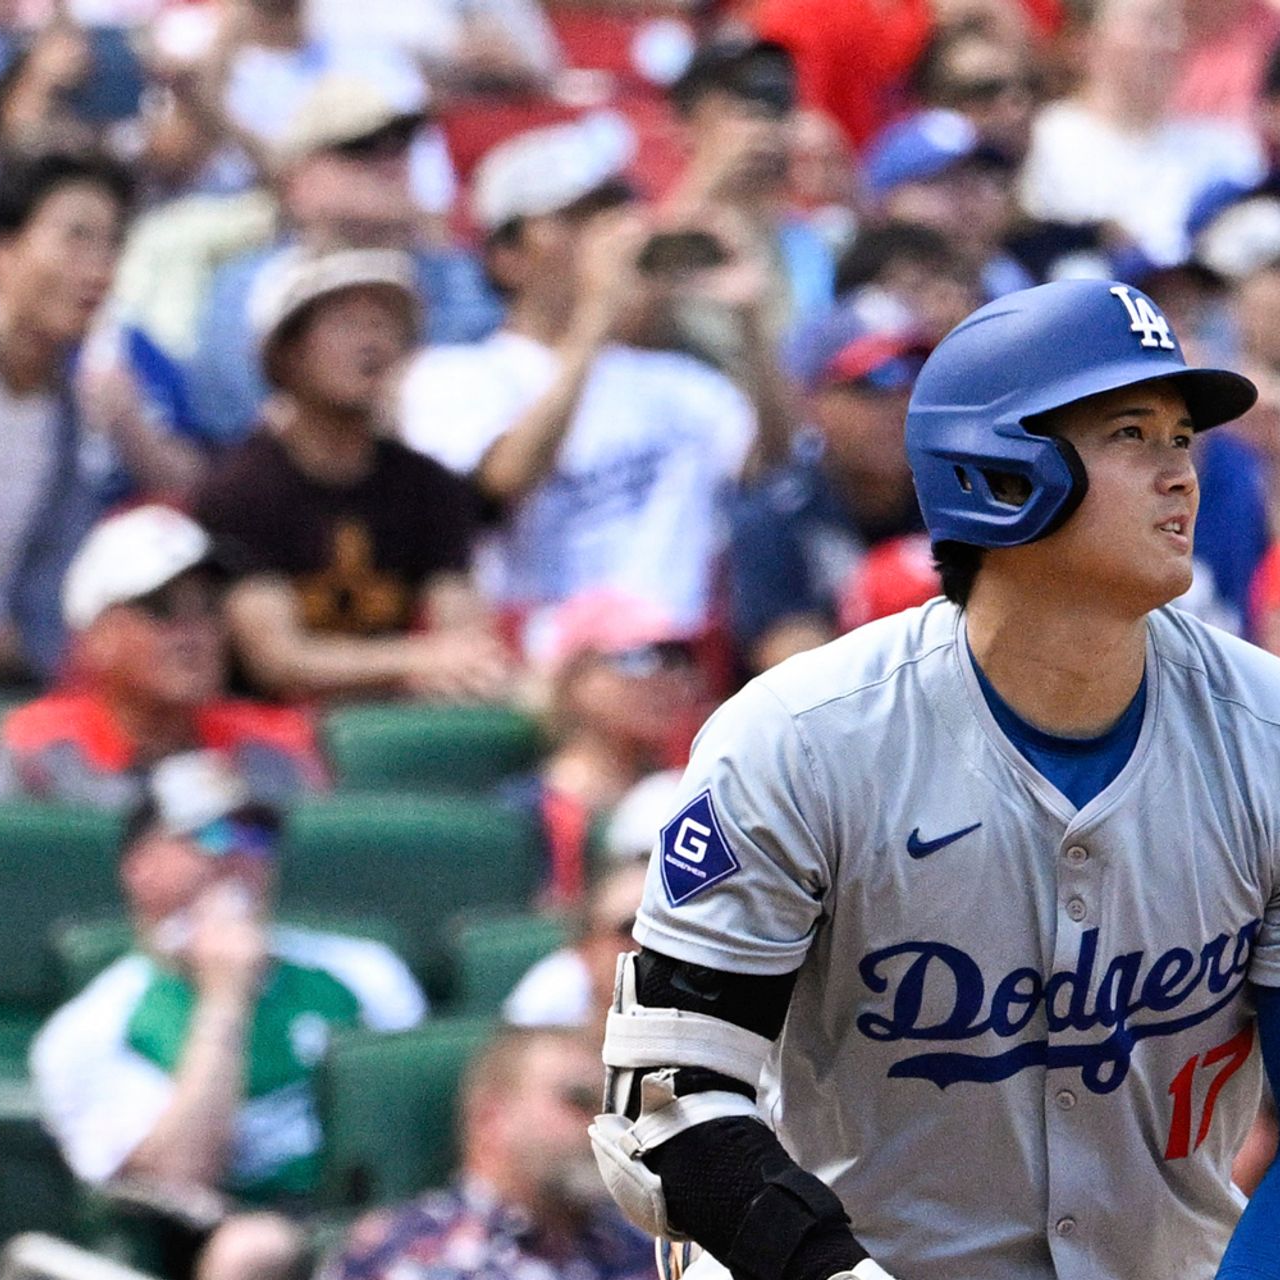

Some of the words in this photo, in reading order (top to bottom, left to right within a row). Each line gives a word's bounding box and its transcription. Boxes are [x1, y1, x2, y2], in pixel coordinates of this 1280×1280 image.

[1109, 286, 1175, 349] LA
[673, 816, 712, 864] G
[1164, 1019, 1255, 1161] 17
